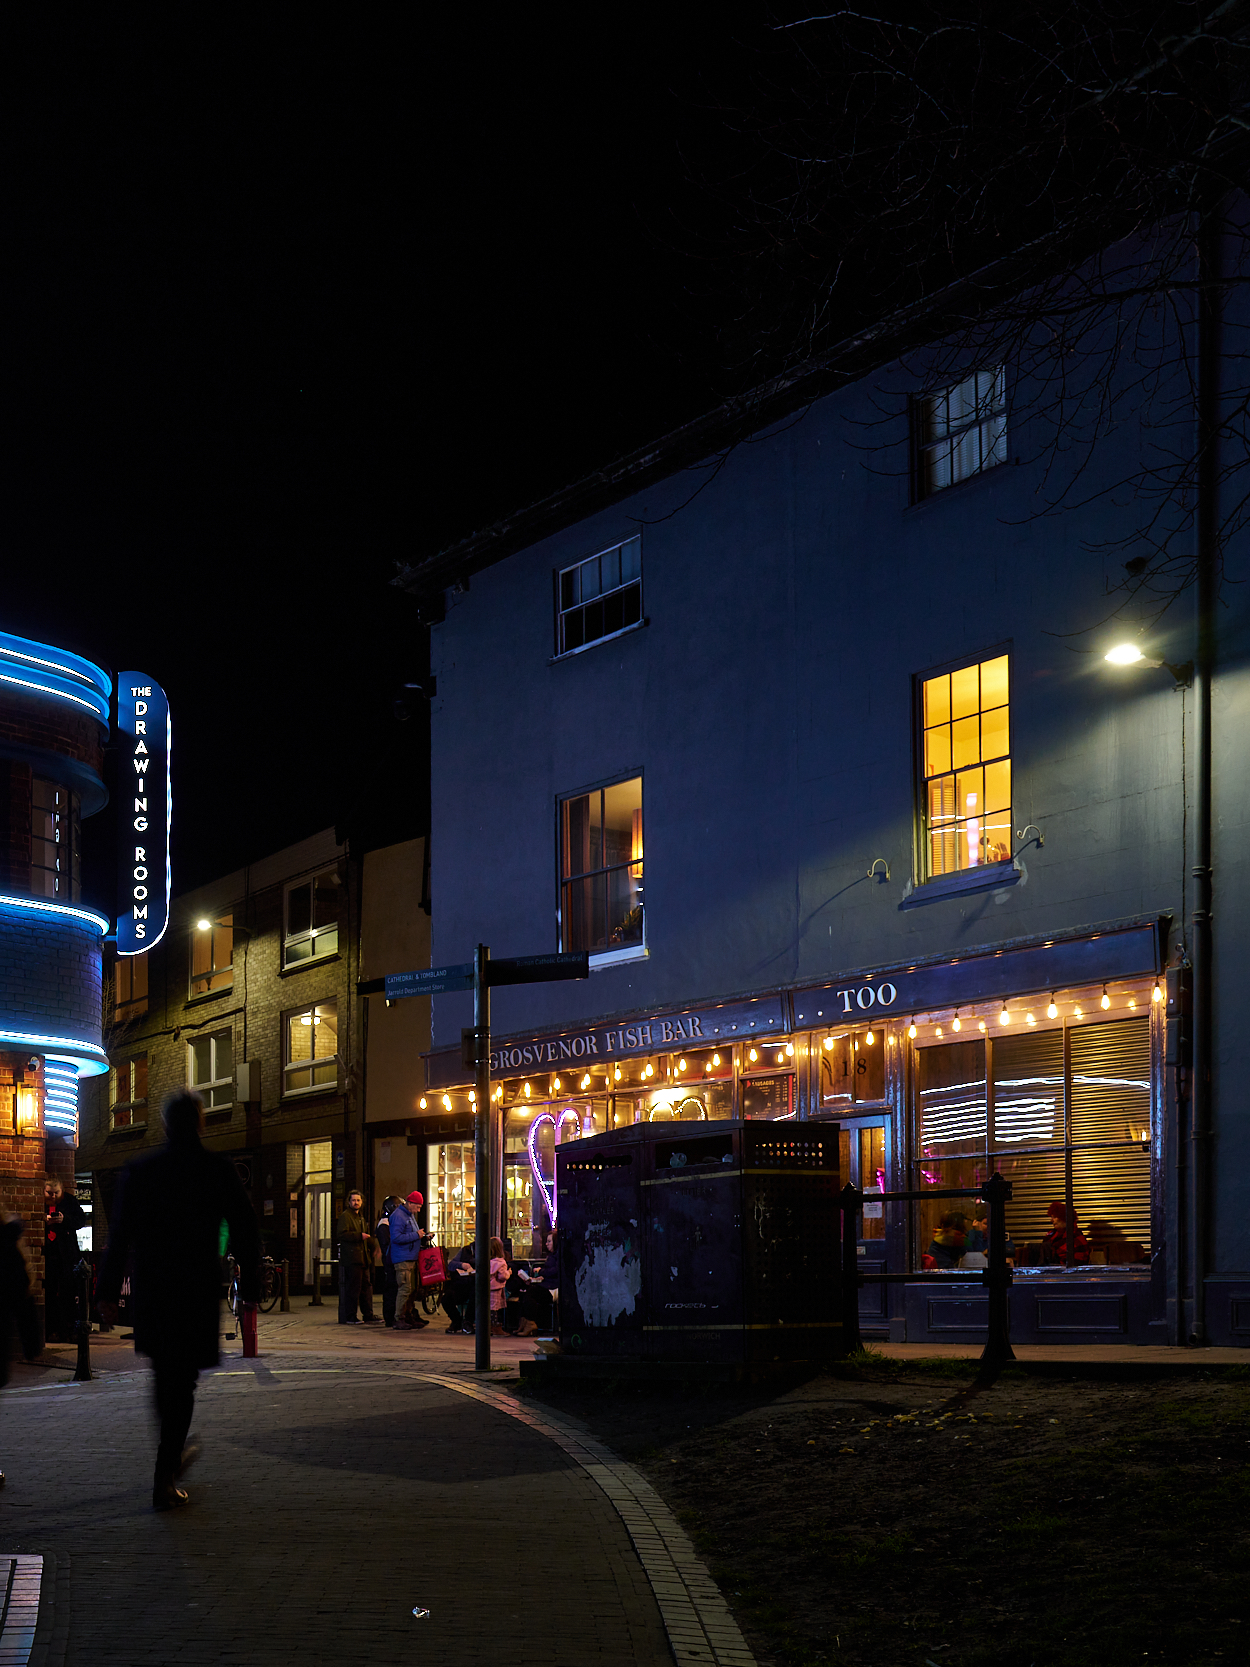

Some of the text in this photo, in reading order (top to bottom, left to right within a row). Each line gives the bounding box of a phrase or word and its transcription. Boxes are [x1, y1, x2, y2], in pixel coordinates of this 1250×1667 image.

[130, 686, 152, 939] THE DRAWING ROOMS
[535, 957, 556, 965] Catholic
[556, 954, 583, 964] Cathedral
[387, 973, 414, 984] CATHEDRAL
[420, 969, 448, 980] TOMBLAND
[387, 983, 445, 997] Jarrold Department Store
[837, 982, 898, 1014] TOO
[489, 1016, 703, 1071] GROSVENOR FISH BAR
